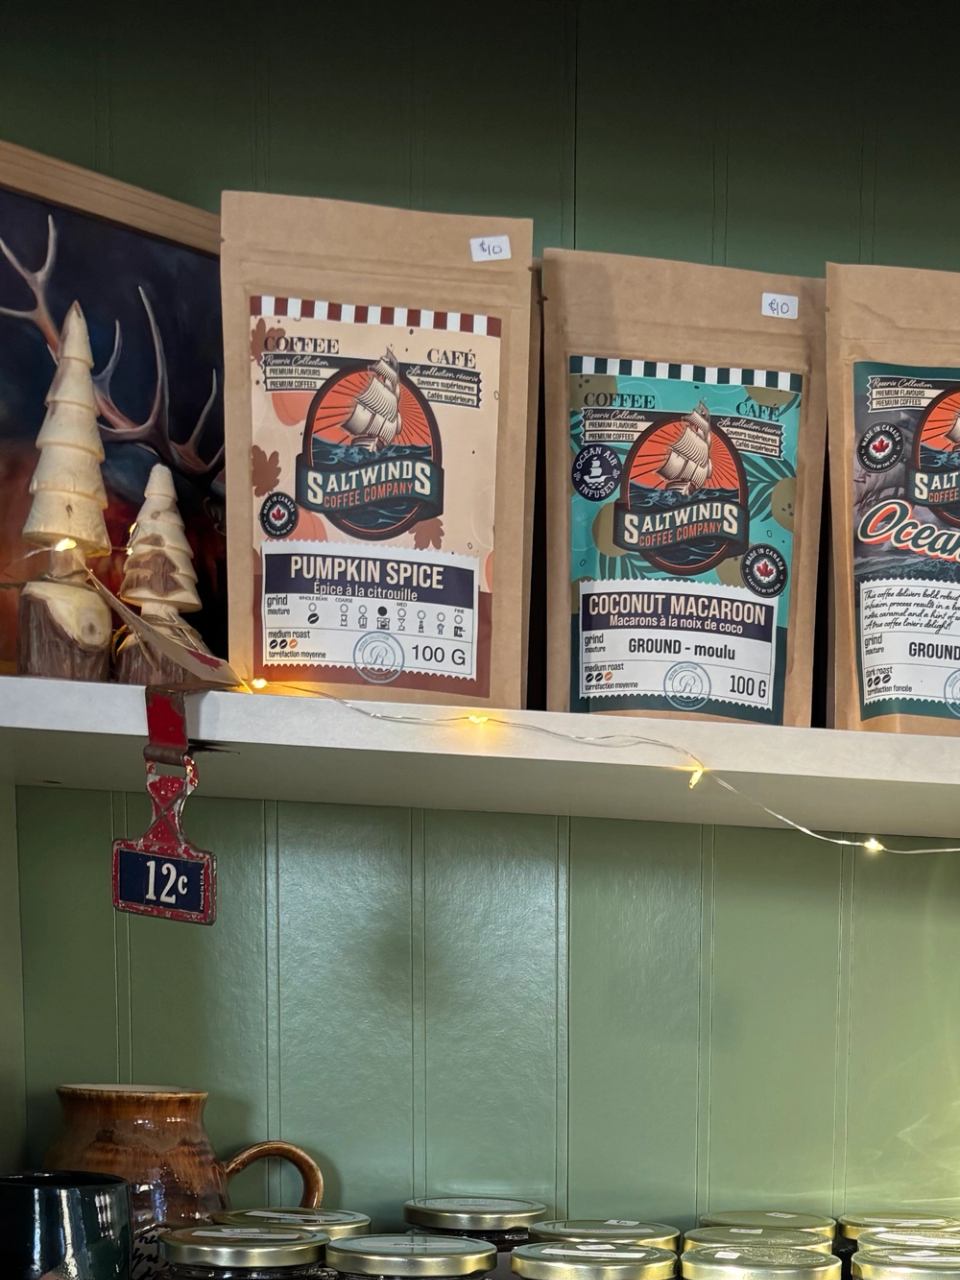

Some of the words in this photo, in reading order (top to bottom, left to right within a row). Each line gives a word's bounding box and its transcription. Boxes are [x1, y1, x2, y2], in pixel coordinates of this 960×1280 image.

[479, 240, 502, 256] $10
[263, 336, 340, 354] COFFEE
[427, 348, 477, 369] CAFÉ
[584, 392, 656, 409] COFFEE
[307, 461, 431, 504] SALTWINDS
[323, 489, 361, 508] COFFEE
[363, 481, 414, 501] COMPANY
[928, 489, 959, 503] COFFEE
[624, 502, 738, 545] SALTWINDS
[291, 556, 380, 583] PUMPKIN
[386, 564, 444, 589] SPICE
[267, 596, 288, 608] grind
[314, 582, 343, 598] Épice
[345, 584, 353, 595] à
[355, 585, 366, 597] la
[367, 587, 418, 602] citrouille
[589, 594, 665, 616] COCONUT
[670, 595, 765, 626] MACAROON
[609, 615, 658, 627] Macarons
[660, 616, 667, 627] à
[668, 616, 678, 627] la
[681, 618, 702, 630] noix
[704, 619, 717, 631] de
[719, 623, 743, 634] coco
[412, 645, 446, 663] 100
[451, 649, 466, 666] G
[628, 638, 682, 654] GROUND
[694, 644, 736, 660] moulu
[729, 675, 756, 696] 100
[757, 681, 767, 698] G
